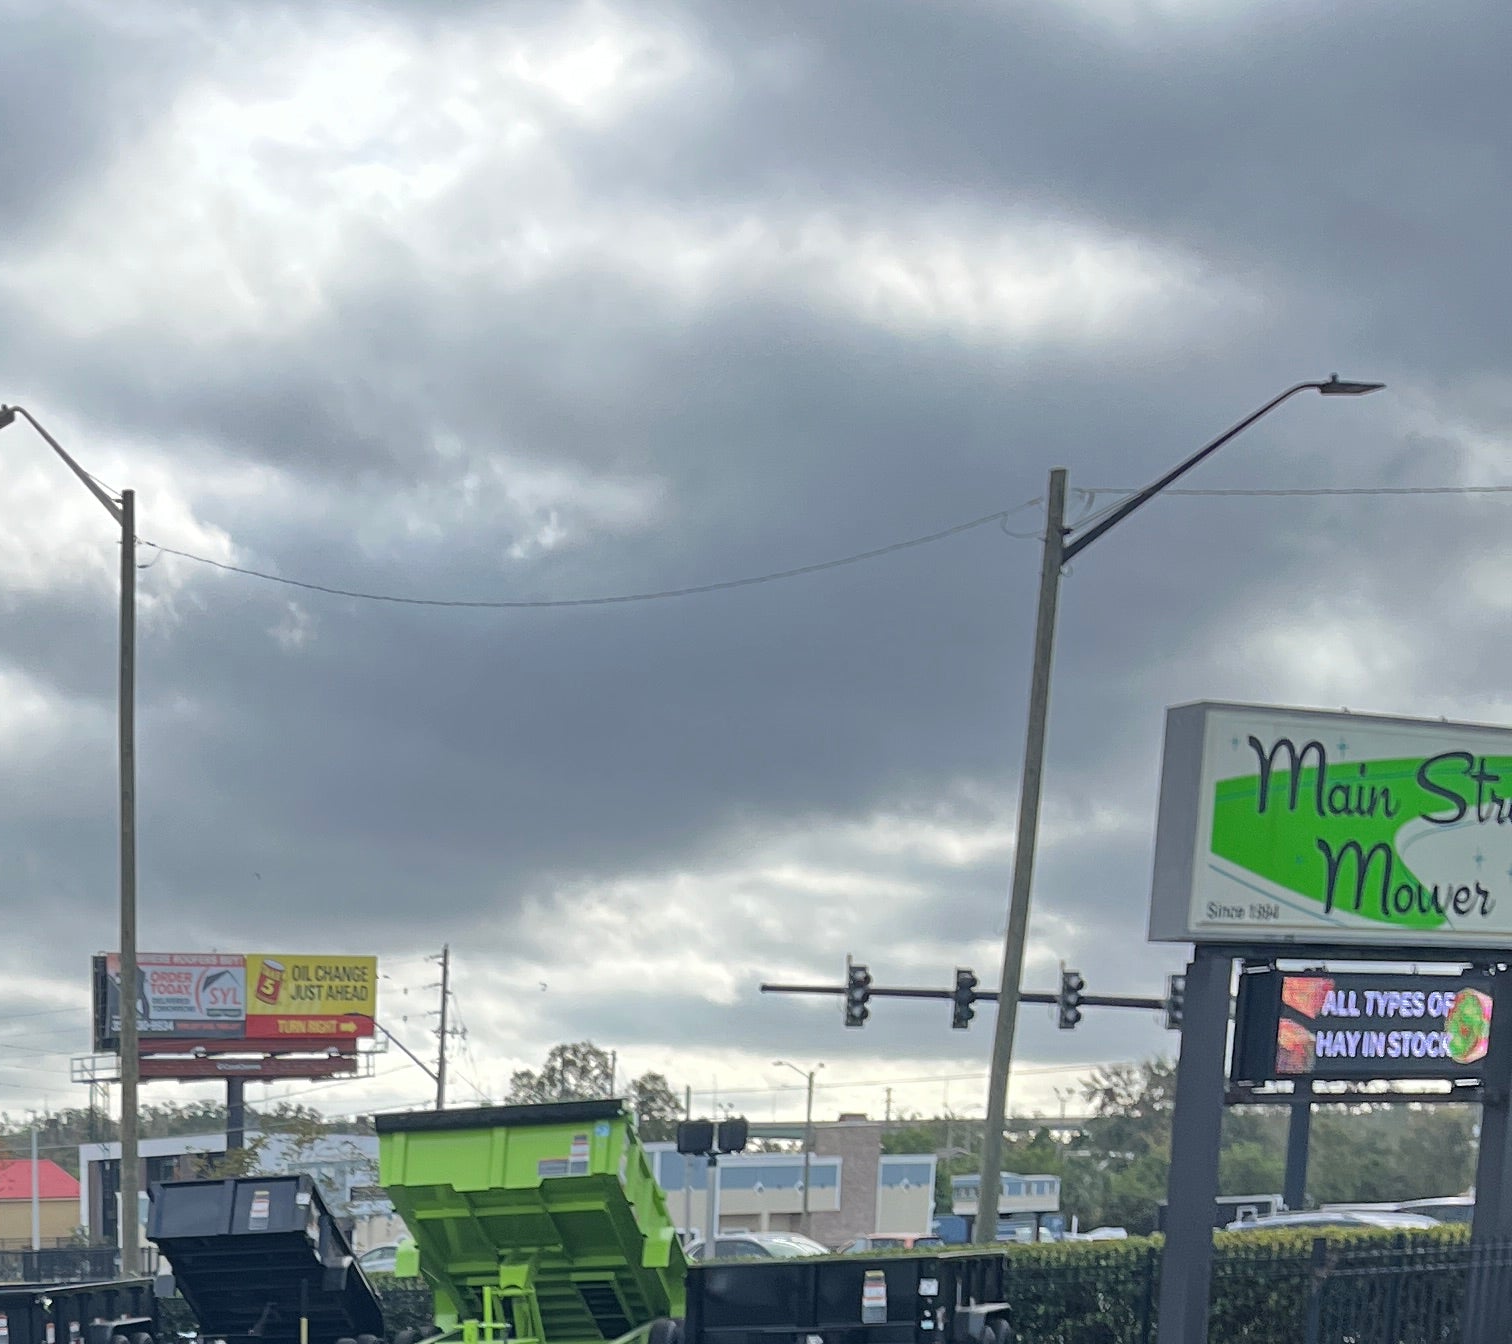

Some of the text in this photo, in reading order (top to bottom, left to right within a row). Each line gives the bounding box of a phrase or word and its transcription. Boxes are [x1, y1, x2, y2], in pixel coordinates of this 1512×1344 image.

[1248, 734, 1512, 825] Main Str
[1316, 837, 1495, 917] Mower
[1206, 903, 1246, 920] Since
[151, 971, 192, 982] ORDER
[292, 965, 369, 982] OIL CHANGE
[261, 979, 275, 995] 5
[290, 984, 369, 1001] JUST AHEAD
[1321, 990, 1456, 1018] ALL TYPES OF
[278, 1020, 306, 1033] TURN
[1315, 1030, 1454, 1058] HAY IN STOCK
